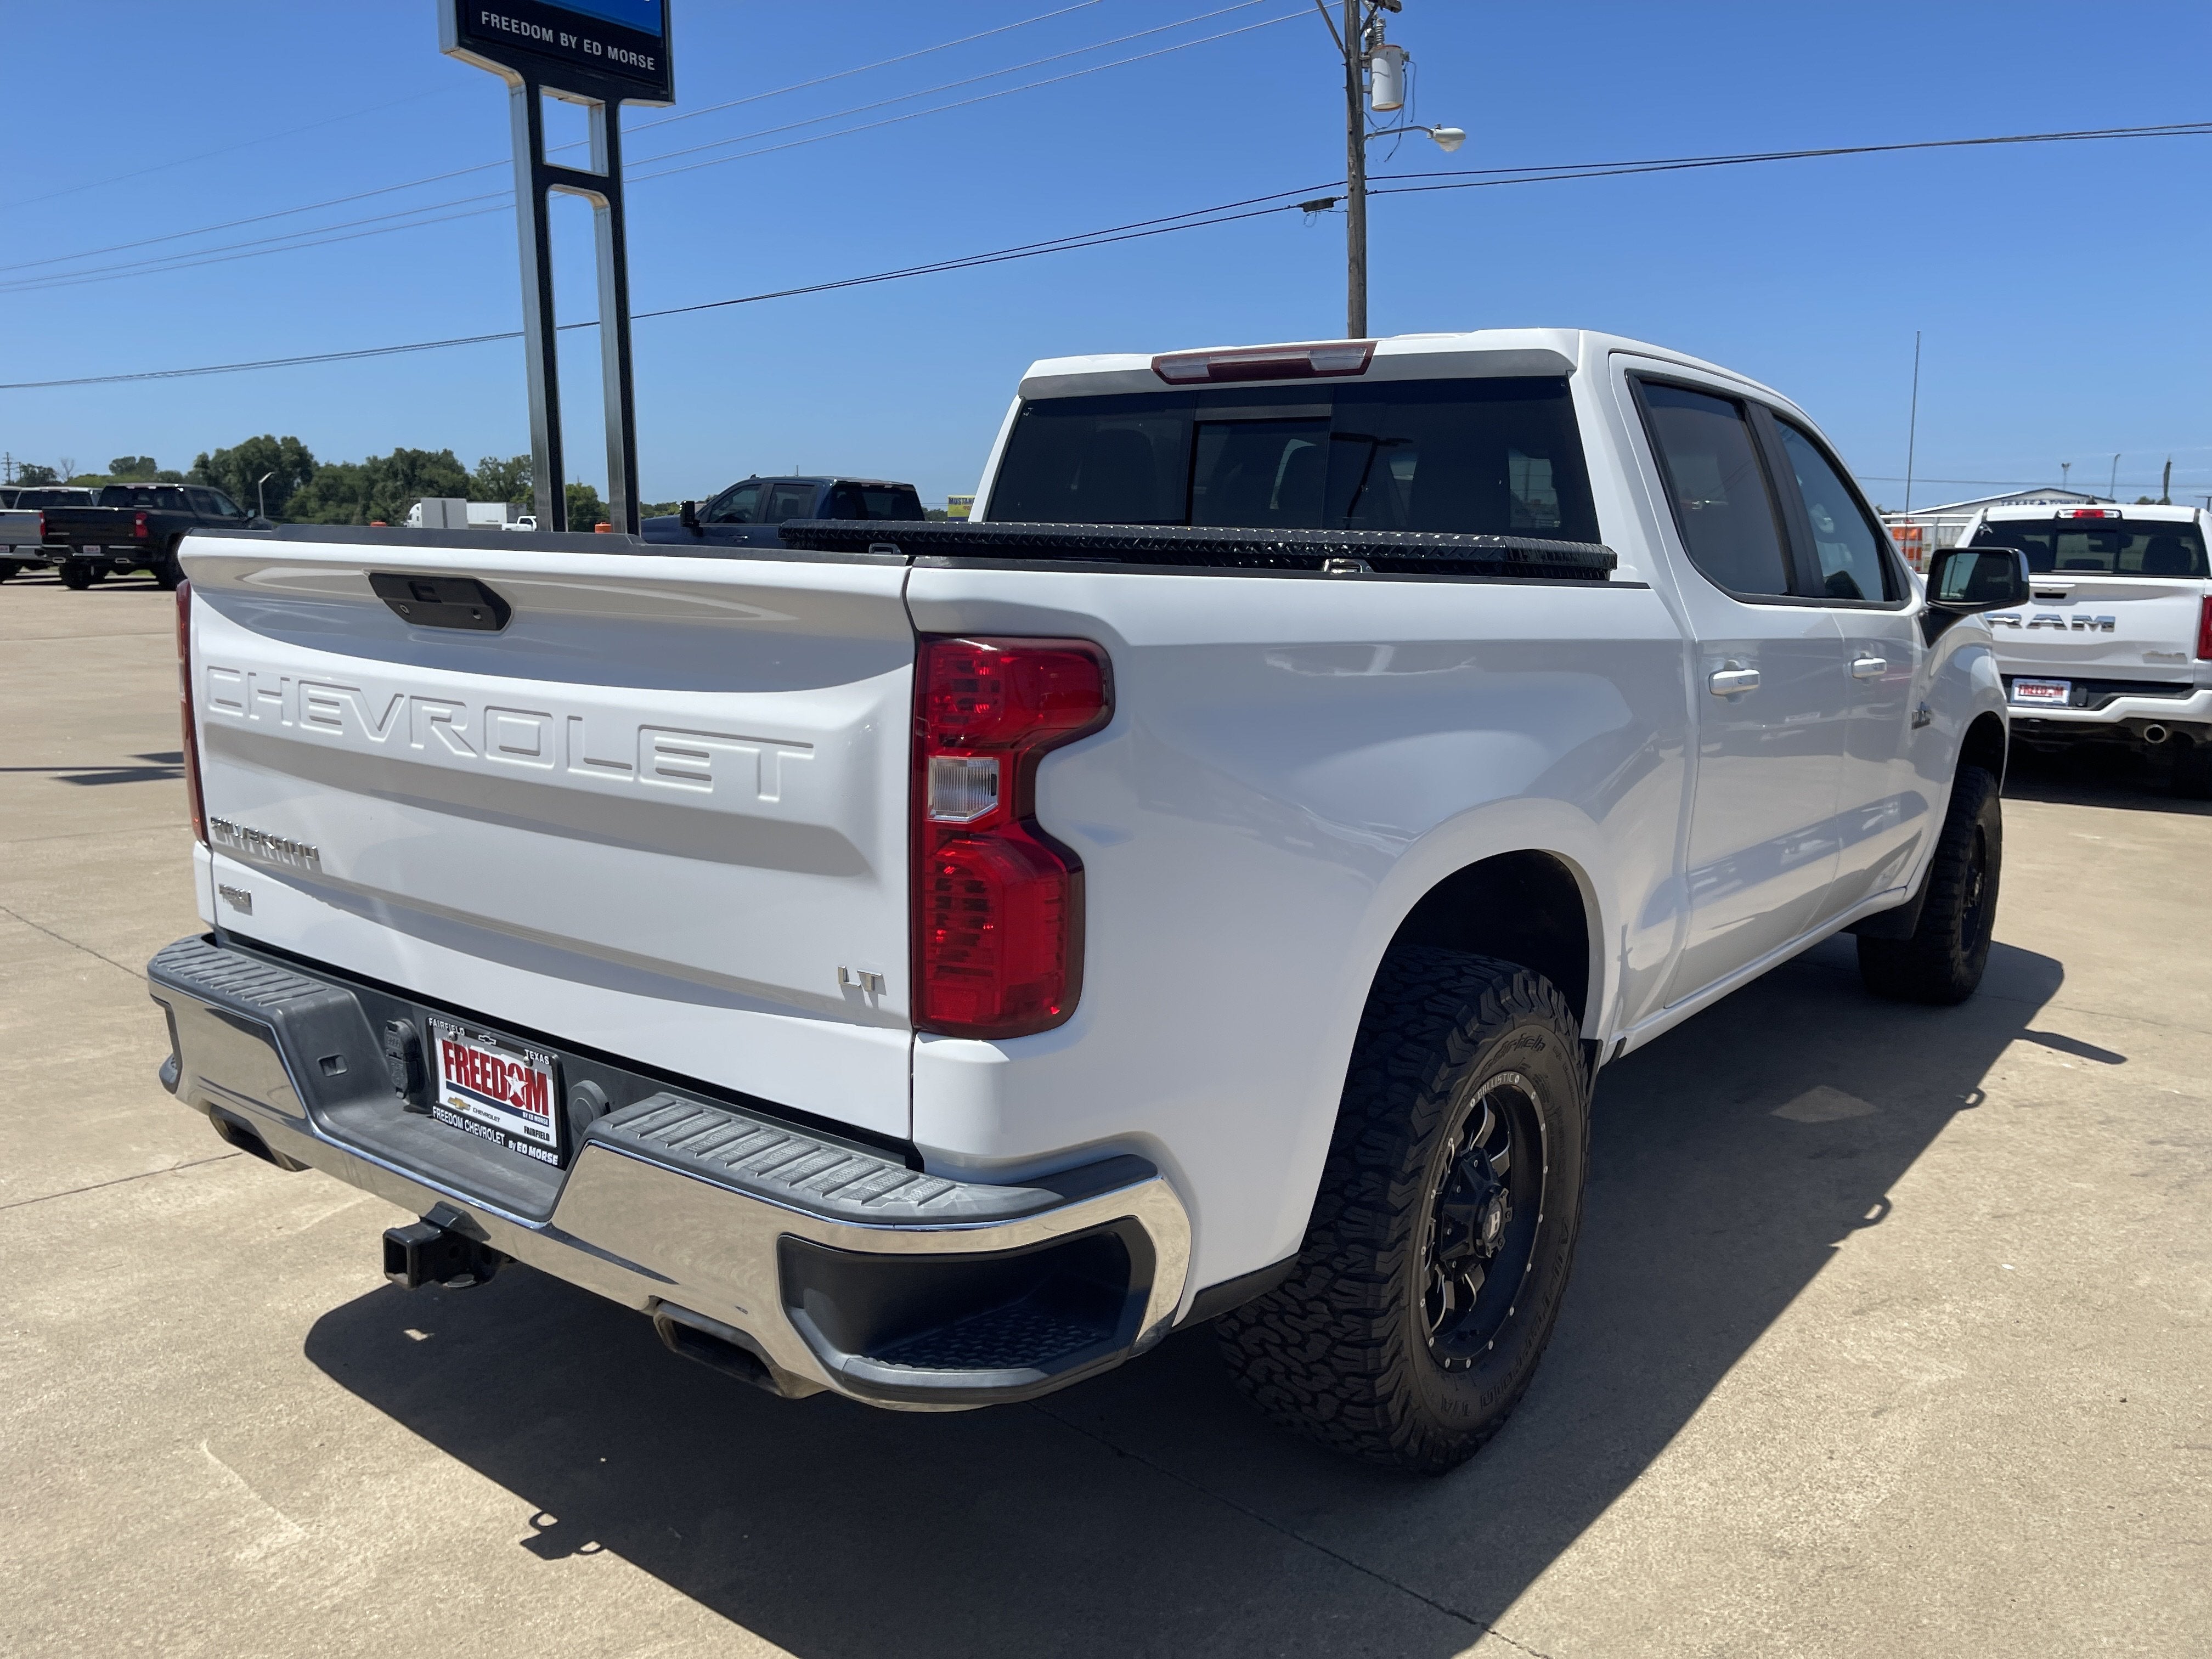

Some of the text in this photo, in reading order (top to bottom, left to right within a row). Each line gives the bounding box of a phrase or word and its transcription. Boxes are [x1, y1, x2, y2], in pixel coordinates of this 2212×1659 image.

[481, 11, 656, 71] FREEDOM BY ED MORSE
[1983, 613, 2116, 633] RAM
[207, 665, 815, 803] CHEVROLET
[838, 966, 883, 992] LT
[428, 1017, 549, 1065] FAIRFIELD TEXAS
[442, 1039, 549, 1117] FREEDOM
[1477, 1073, 1514, 1099] BALLISTIC
[432, 1105, 463, 1130] FREEDOM
[464, 1120, 505, 1146] CHEVROLET
[517, 1142, 528, 1154] ED
[528, 1147, 558, 1166] MORSE
